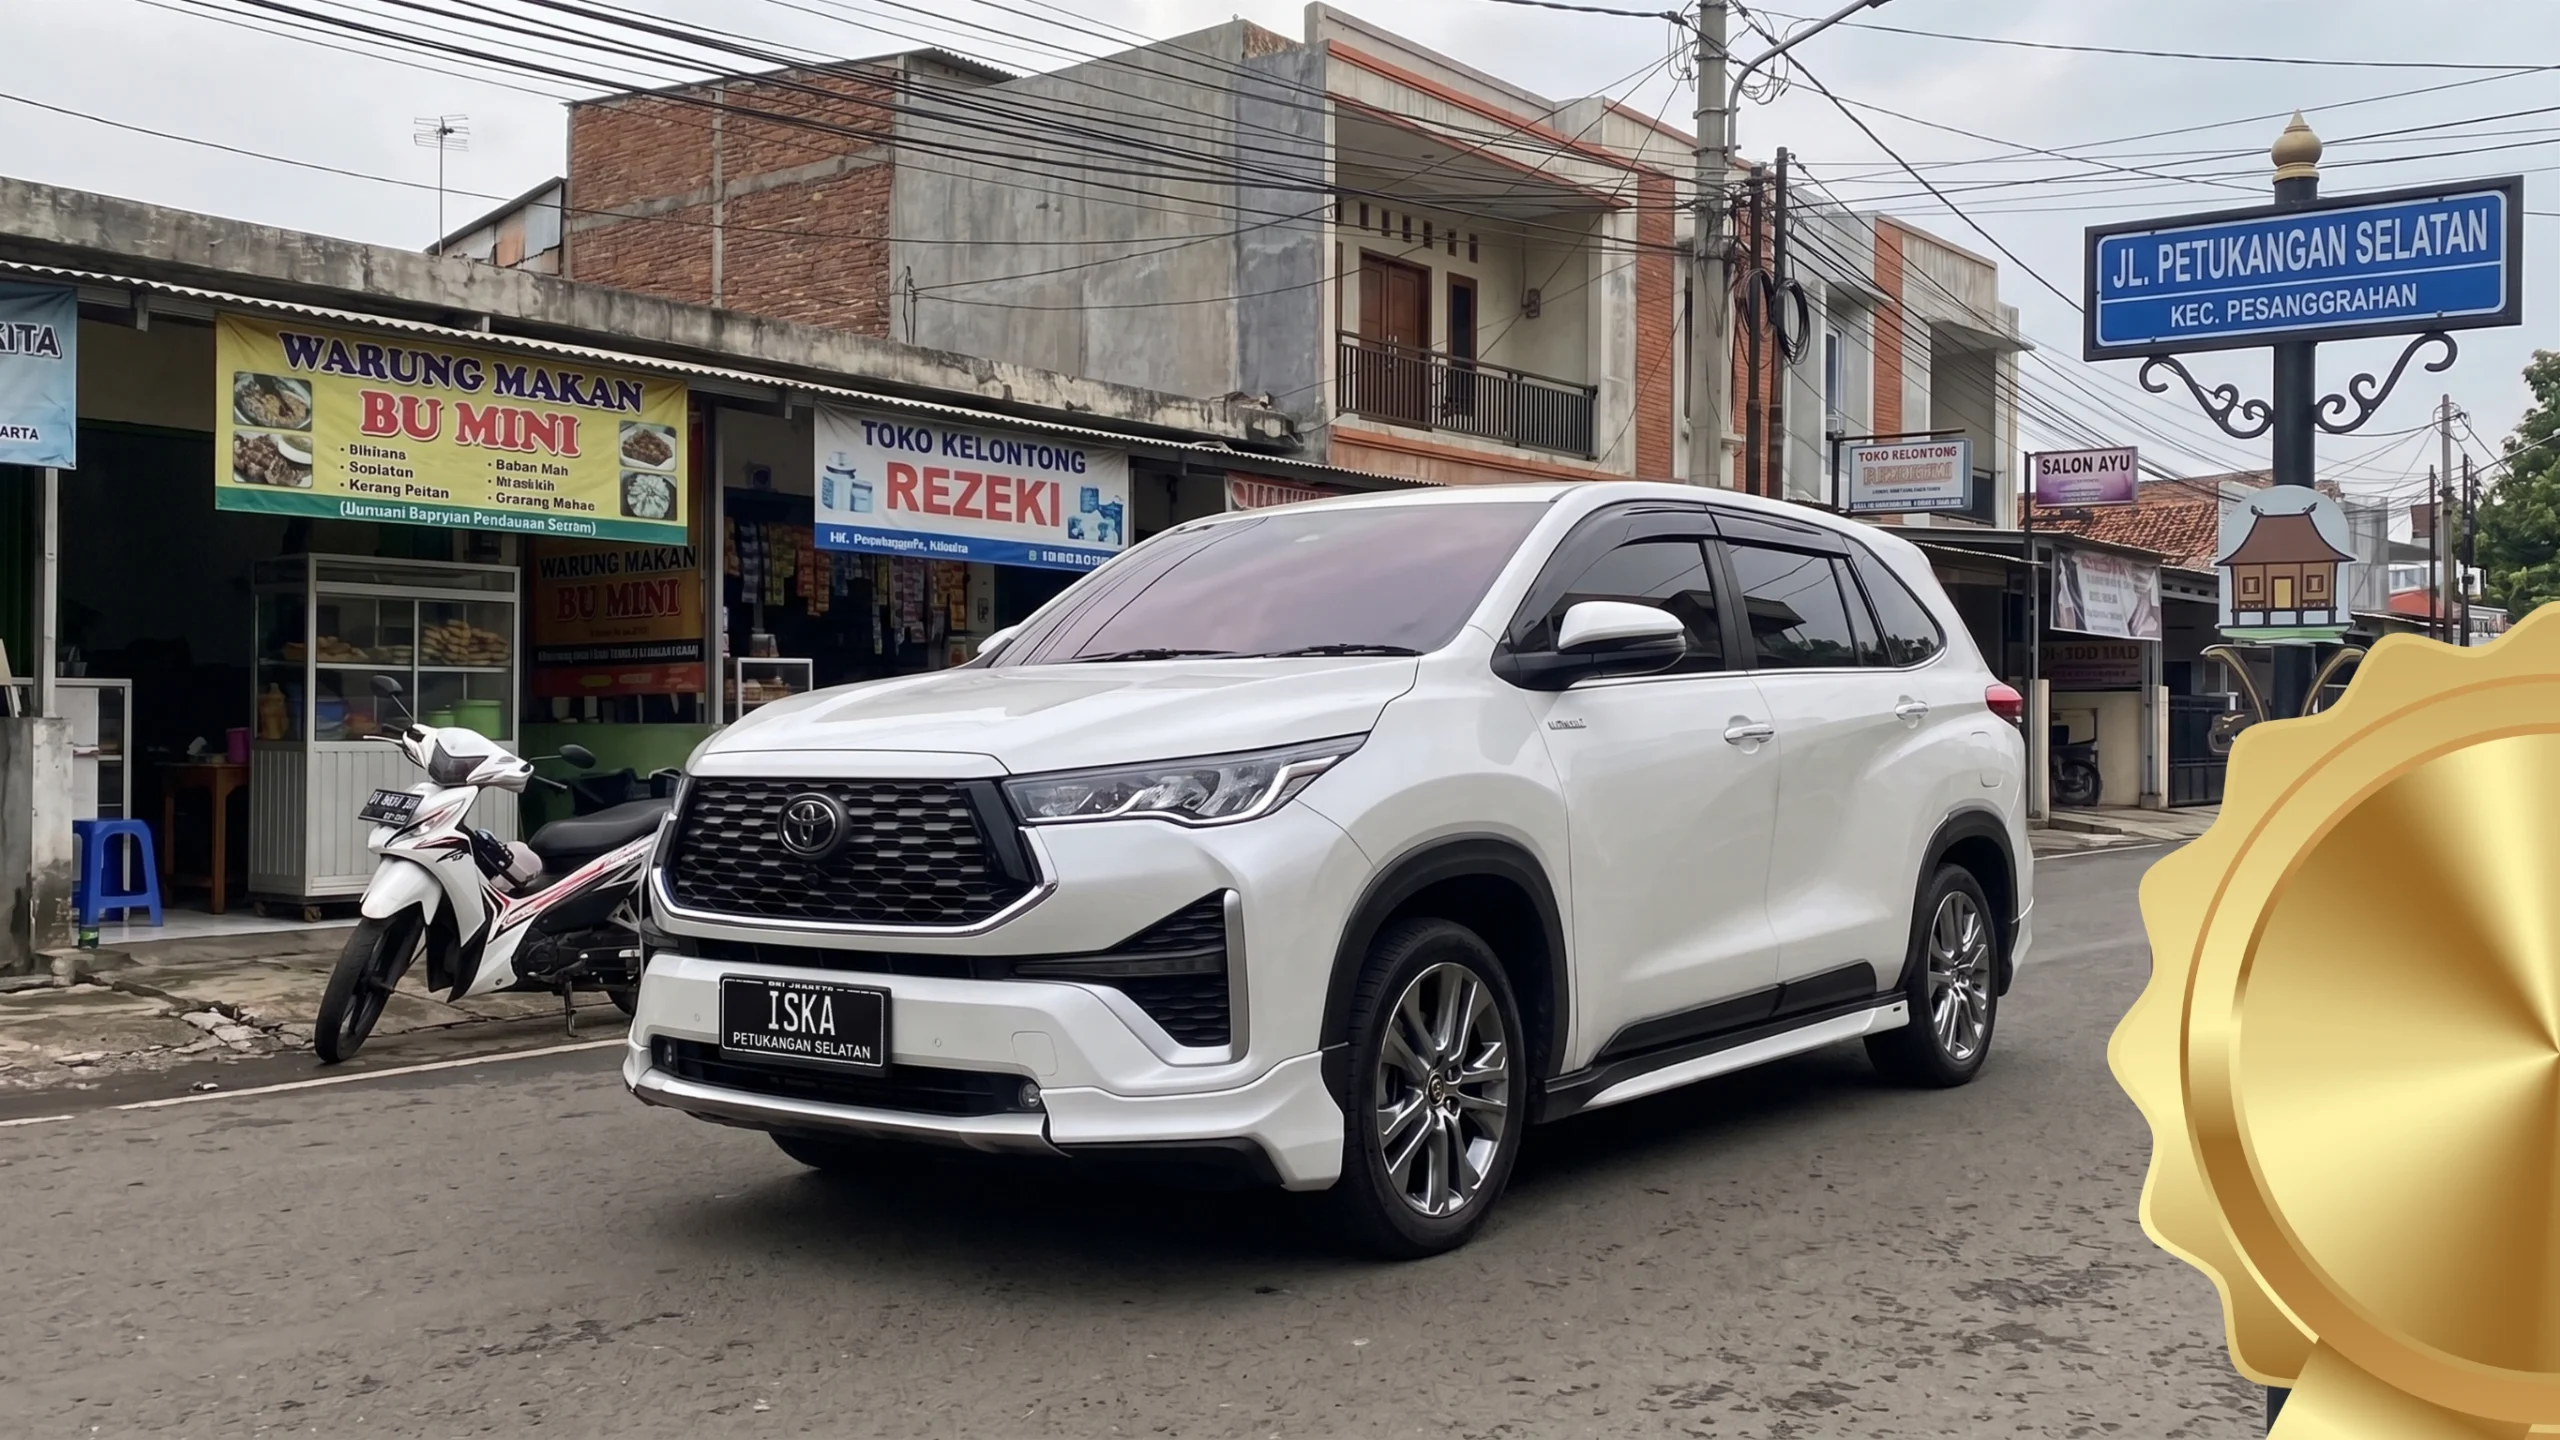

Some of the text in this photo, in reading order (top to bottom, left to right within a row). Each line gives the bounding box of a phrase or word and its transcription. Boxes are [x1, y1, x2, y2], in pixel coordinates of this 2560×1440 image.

[2112, 207, 2488, 289] JL. PETUKANGAN SELATAN
[2170, 282, 2417, 328] KEC. PESANGGRAHAN
[278, 332, 644, 415] WARUNG MAKAN
[360, 390, 581, 457] BU MINI
[496, 459, 568, 476] Baban Mah
[861, 420, 1086, 474] TOKO KELONTONG
[1858, 450, 1889, 463] TOKO
[2042, 454, 2130, 475] SALON AYU
[350, 478, 401, 497] Kerang
[887, 461, 1060, 527] REZEKI
[540, 545, 697, 578] WARUNG MAKAN
[556, 577, 681, 622] BU MINI
[768, 990, 836, 1036] ISKA
[733, 1031, 871, 1059] PETUKANGAN SELATAN
